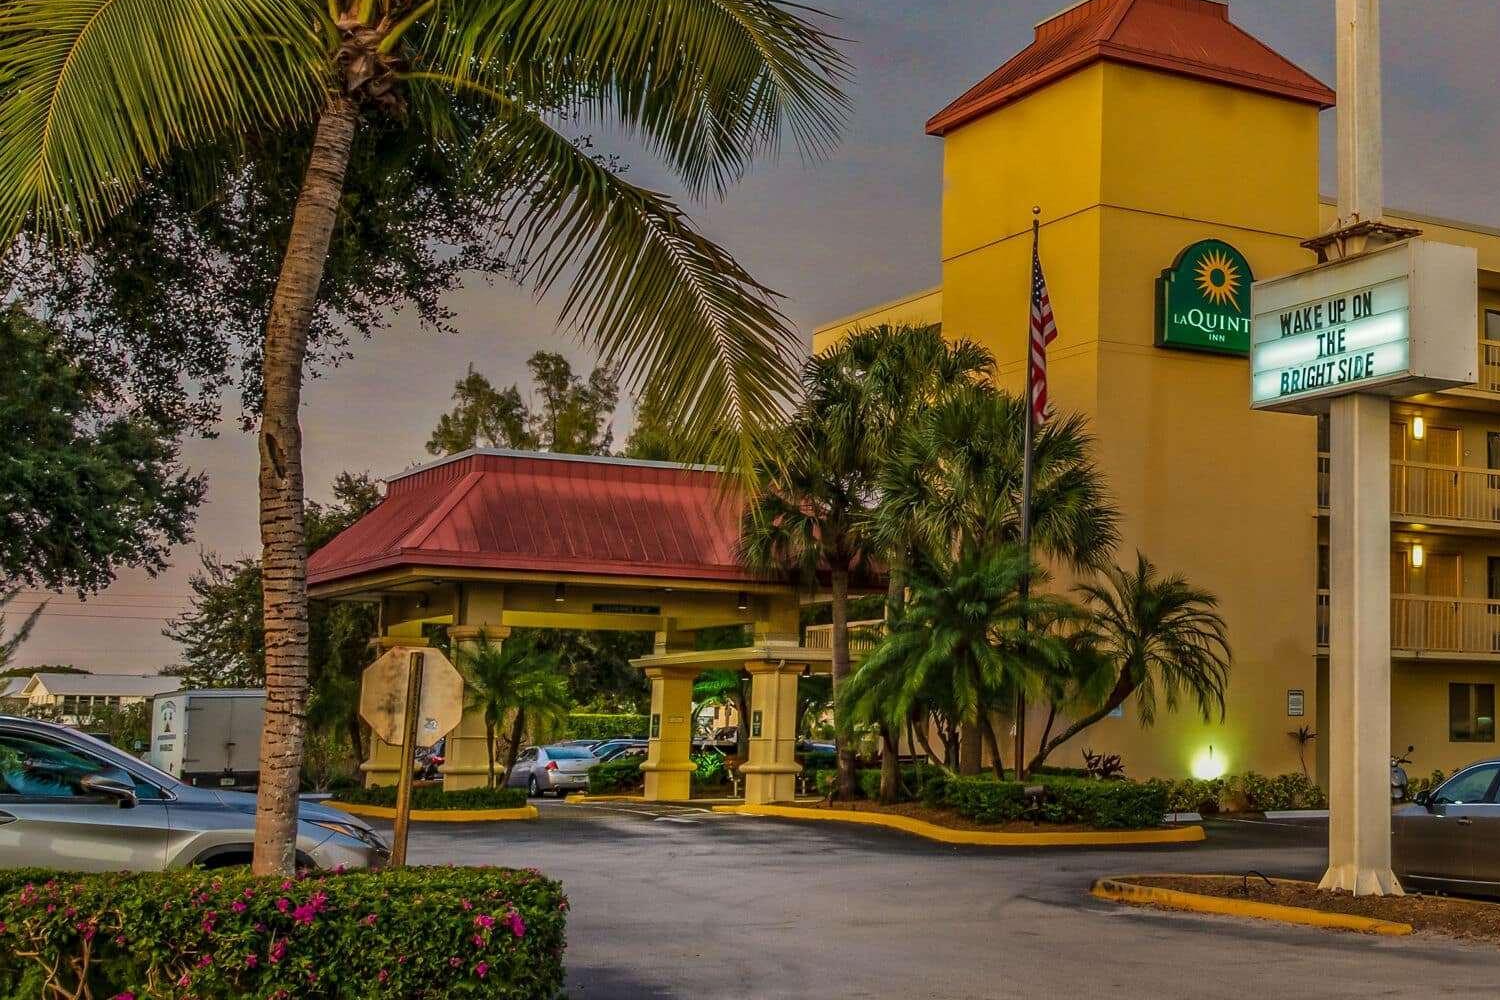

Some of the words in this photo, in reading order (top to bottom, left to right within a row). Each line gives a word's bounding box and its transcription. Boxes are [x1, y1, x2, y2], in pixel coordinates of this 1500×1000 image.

[1173, 313, 1188, 325] LA
[1187, 308, 1252, 334] QUINT
[1280, 304, 1323, 337] WAKE
[1328, 298, 1347, 326] UP
[1352, 291, 1373, 318] ON
[1208, 333, 1226, 343] INN
[1316, 326, 1346, 359] THE
[1280, 360, 1335, 397] BRIGHT
[1337, 352, 1375, 384] SIDE
